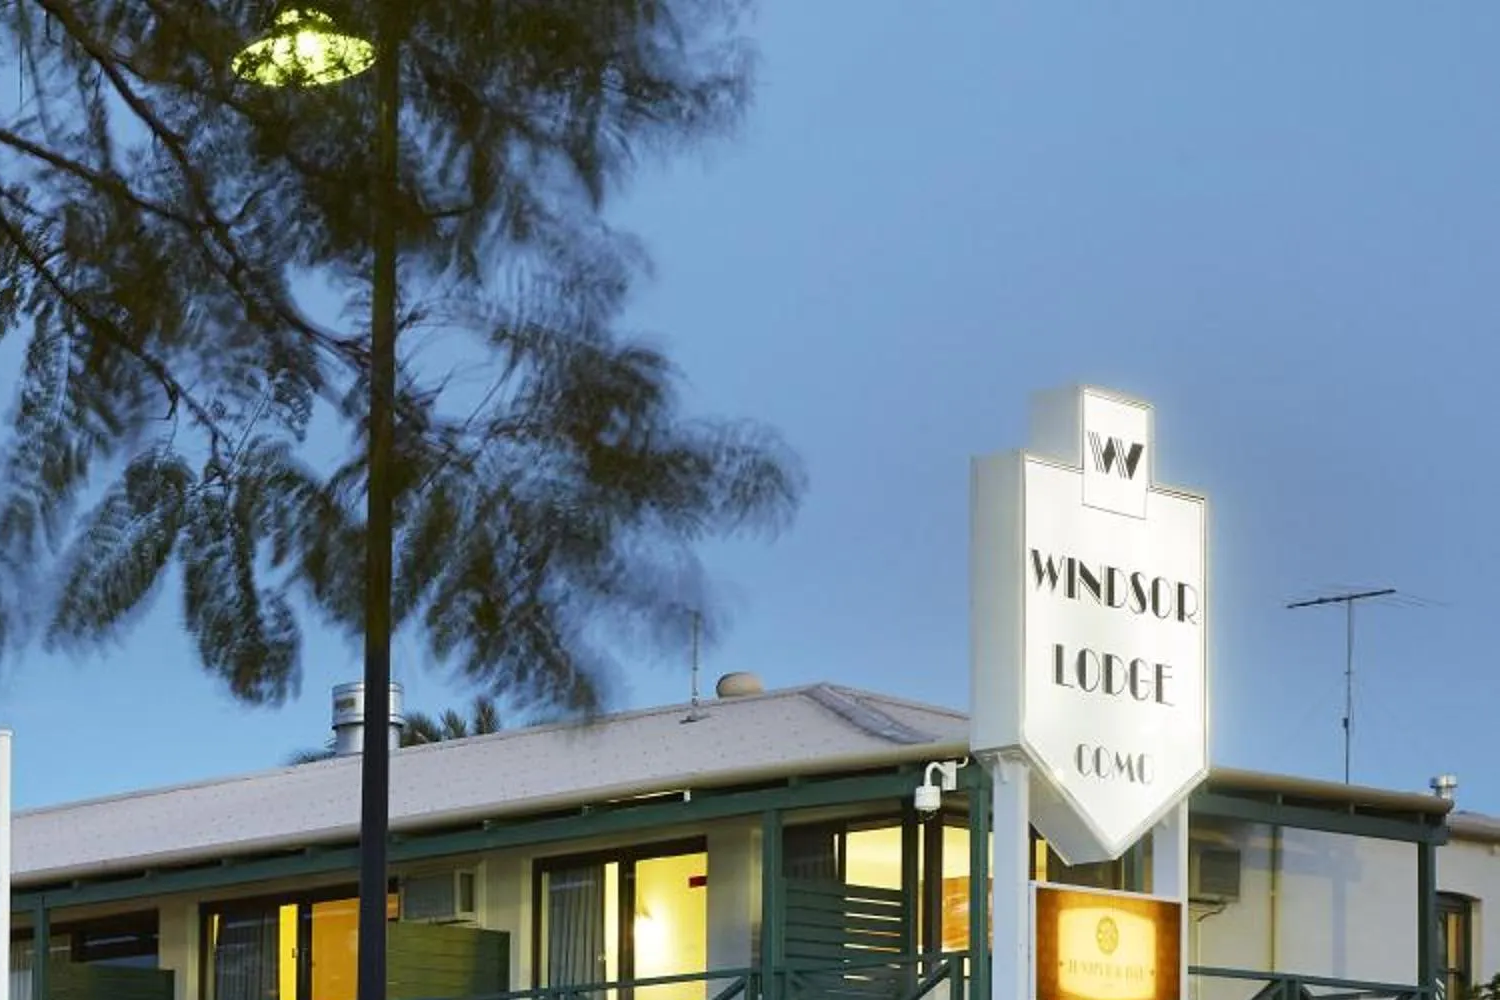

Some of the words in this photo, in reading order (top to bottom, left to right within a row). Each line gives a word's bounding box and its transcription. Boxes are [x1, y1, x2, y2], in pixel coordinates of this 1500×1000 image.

[1087, 431, 1145, 480] W
[1030, 548, 1199, 626] WINDSOR
[1052, 643, 1175, 707] LODGE
[1075, 743, 1155, 785] COMO
